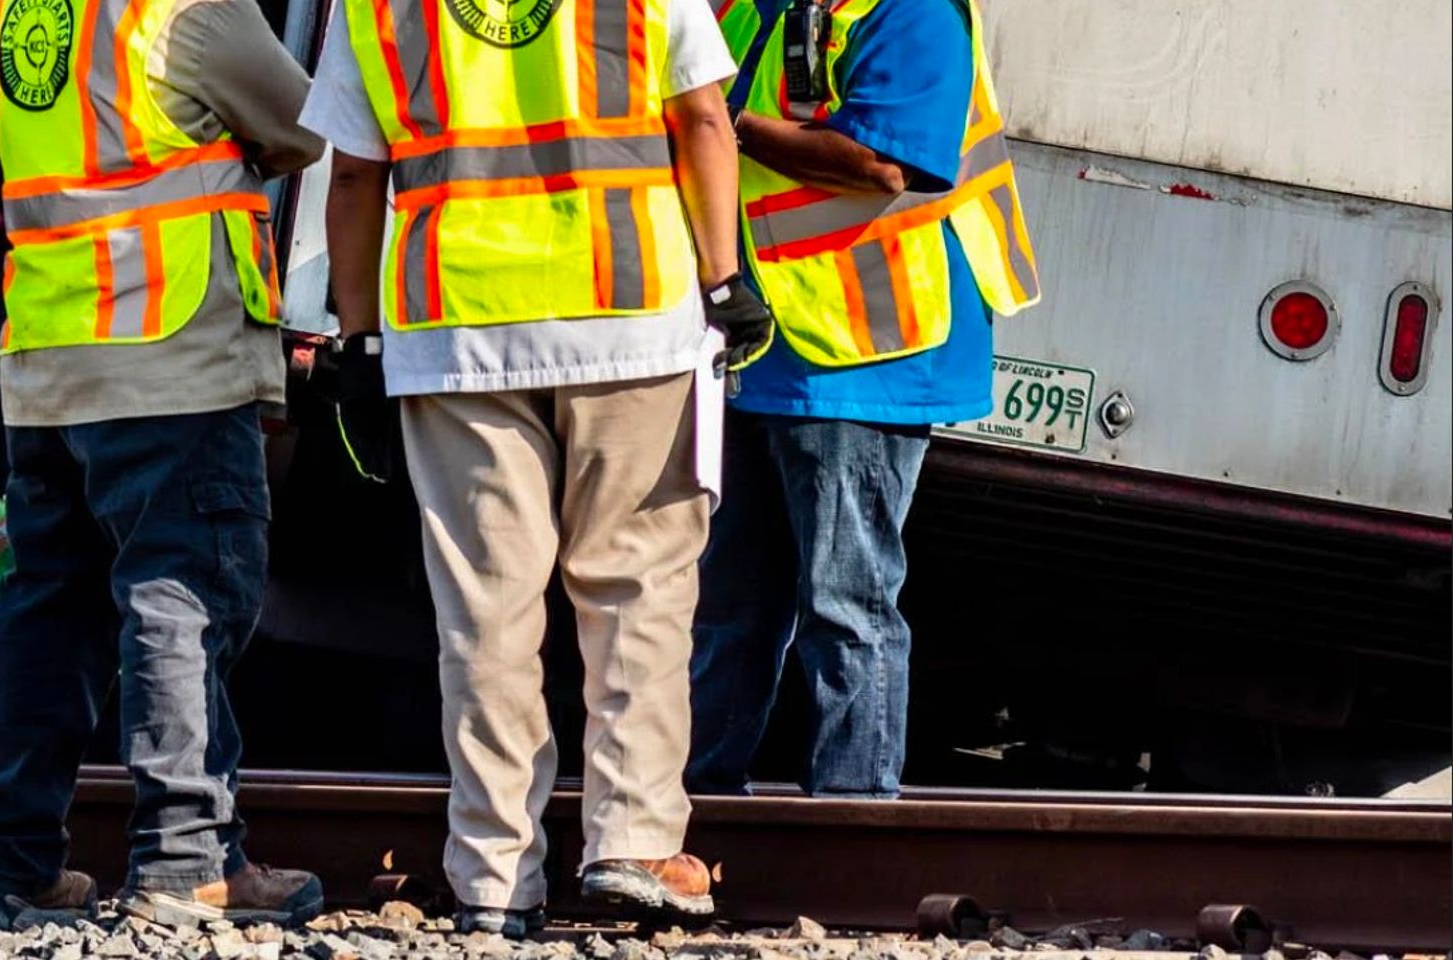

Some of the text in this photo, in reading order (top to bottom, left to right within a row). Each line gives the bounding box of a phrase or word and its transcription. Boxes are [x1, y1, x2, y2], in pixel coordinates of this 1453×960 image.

[484, 20, 531, 41] HERE
[29, 40, 46, 53] KCS
[998, 362, 1012, 373] OF
[1012, 363, 1054, 379] LINCOLN
[1004, 379, 1065, 427] 699
[977, 421, 1024, 439] ILLINOIS
